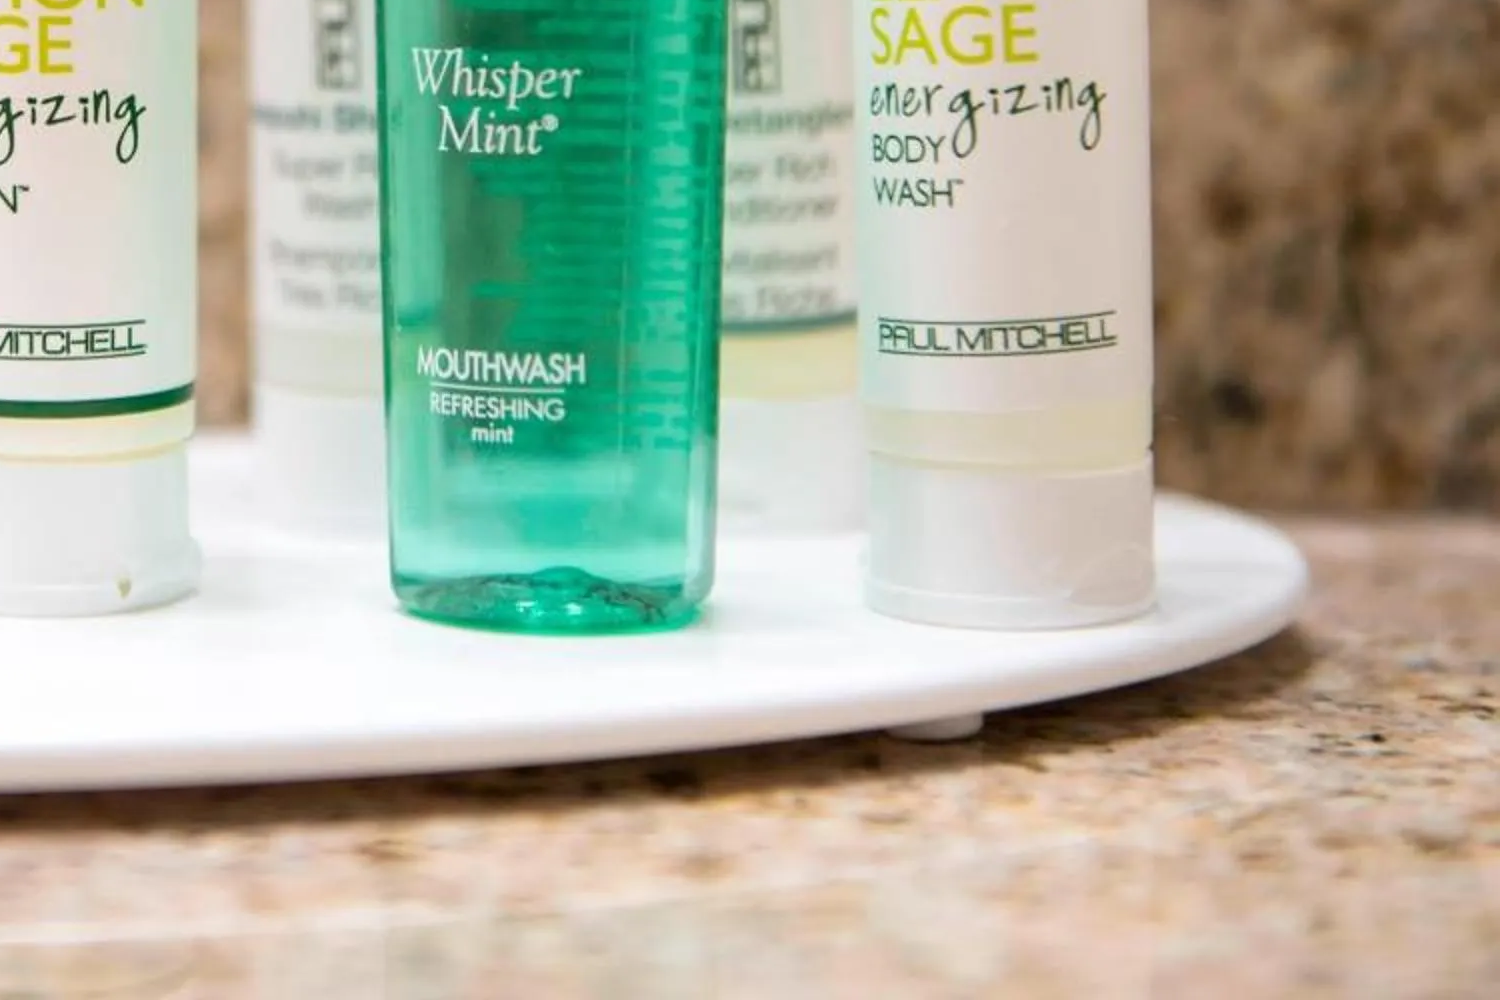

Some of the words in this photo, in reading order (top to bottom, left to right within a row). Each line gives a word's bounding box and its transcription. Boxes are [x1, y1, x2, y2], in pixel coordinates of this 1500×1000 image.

[871, 4, 1038, 65] SAGE
[411, 46, 581, 111] Whisper
[438, 105, 559, 155] Mint®
[869, 75, 1106, 158] energizing
[873, 134, 945, 164] BODY
[879, 321, 949, 351] PAUL
[955, 314, 1116, 349] MITCHELL
[417, 345, 586, 386] MOUTHWASH
[429, 390, 565, 421] REFRESHING
[471, 424, 514, 443] mint
